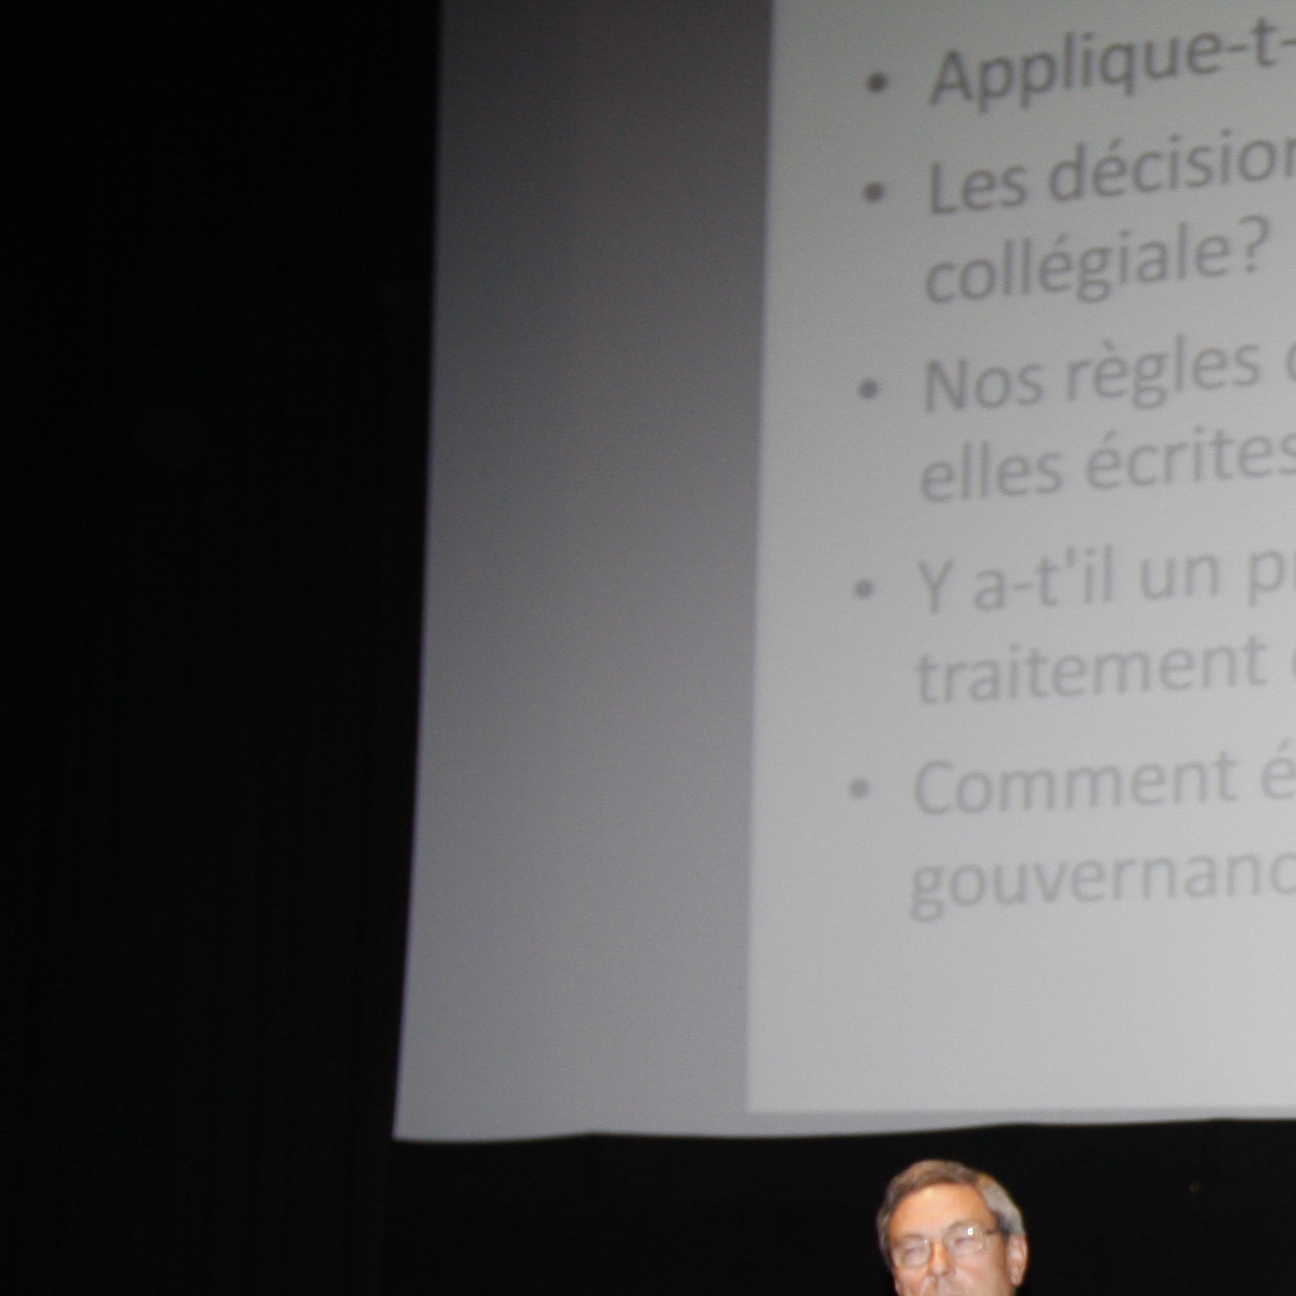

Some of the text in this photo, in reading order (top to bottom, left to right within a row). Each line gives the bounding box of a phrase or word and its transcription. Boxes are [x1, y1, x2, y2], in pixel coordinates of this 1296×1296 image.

[928, 161, 1030, 217] Les
[923, 213, 1273, 305] collégiale?
[924, 358, 1046, 413] Nos
[1066, 334, 1263, 411] règles
[919, 441, 1065, 504] elles
[917, 560, 955, 614] Y
[972, 546, 1114, 612] a-t'il
[1139, 554, 1221, 601] un
[915, 635, 1268, 705] traitement
[913, 751, 1237, 816] Comment
